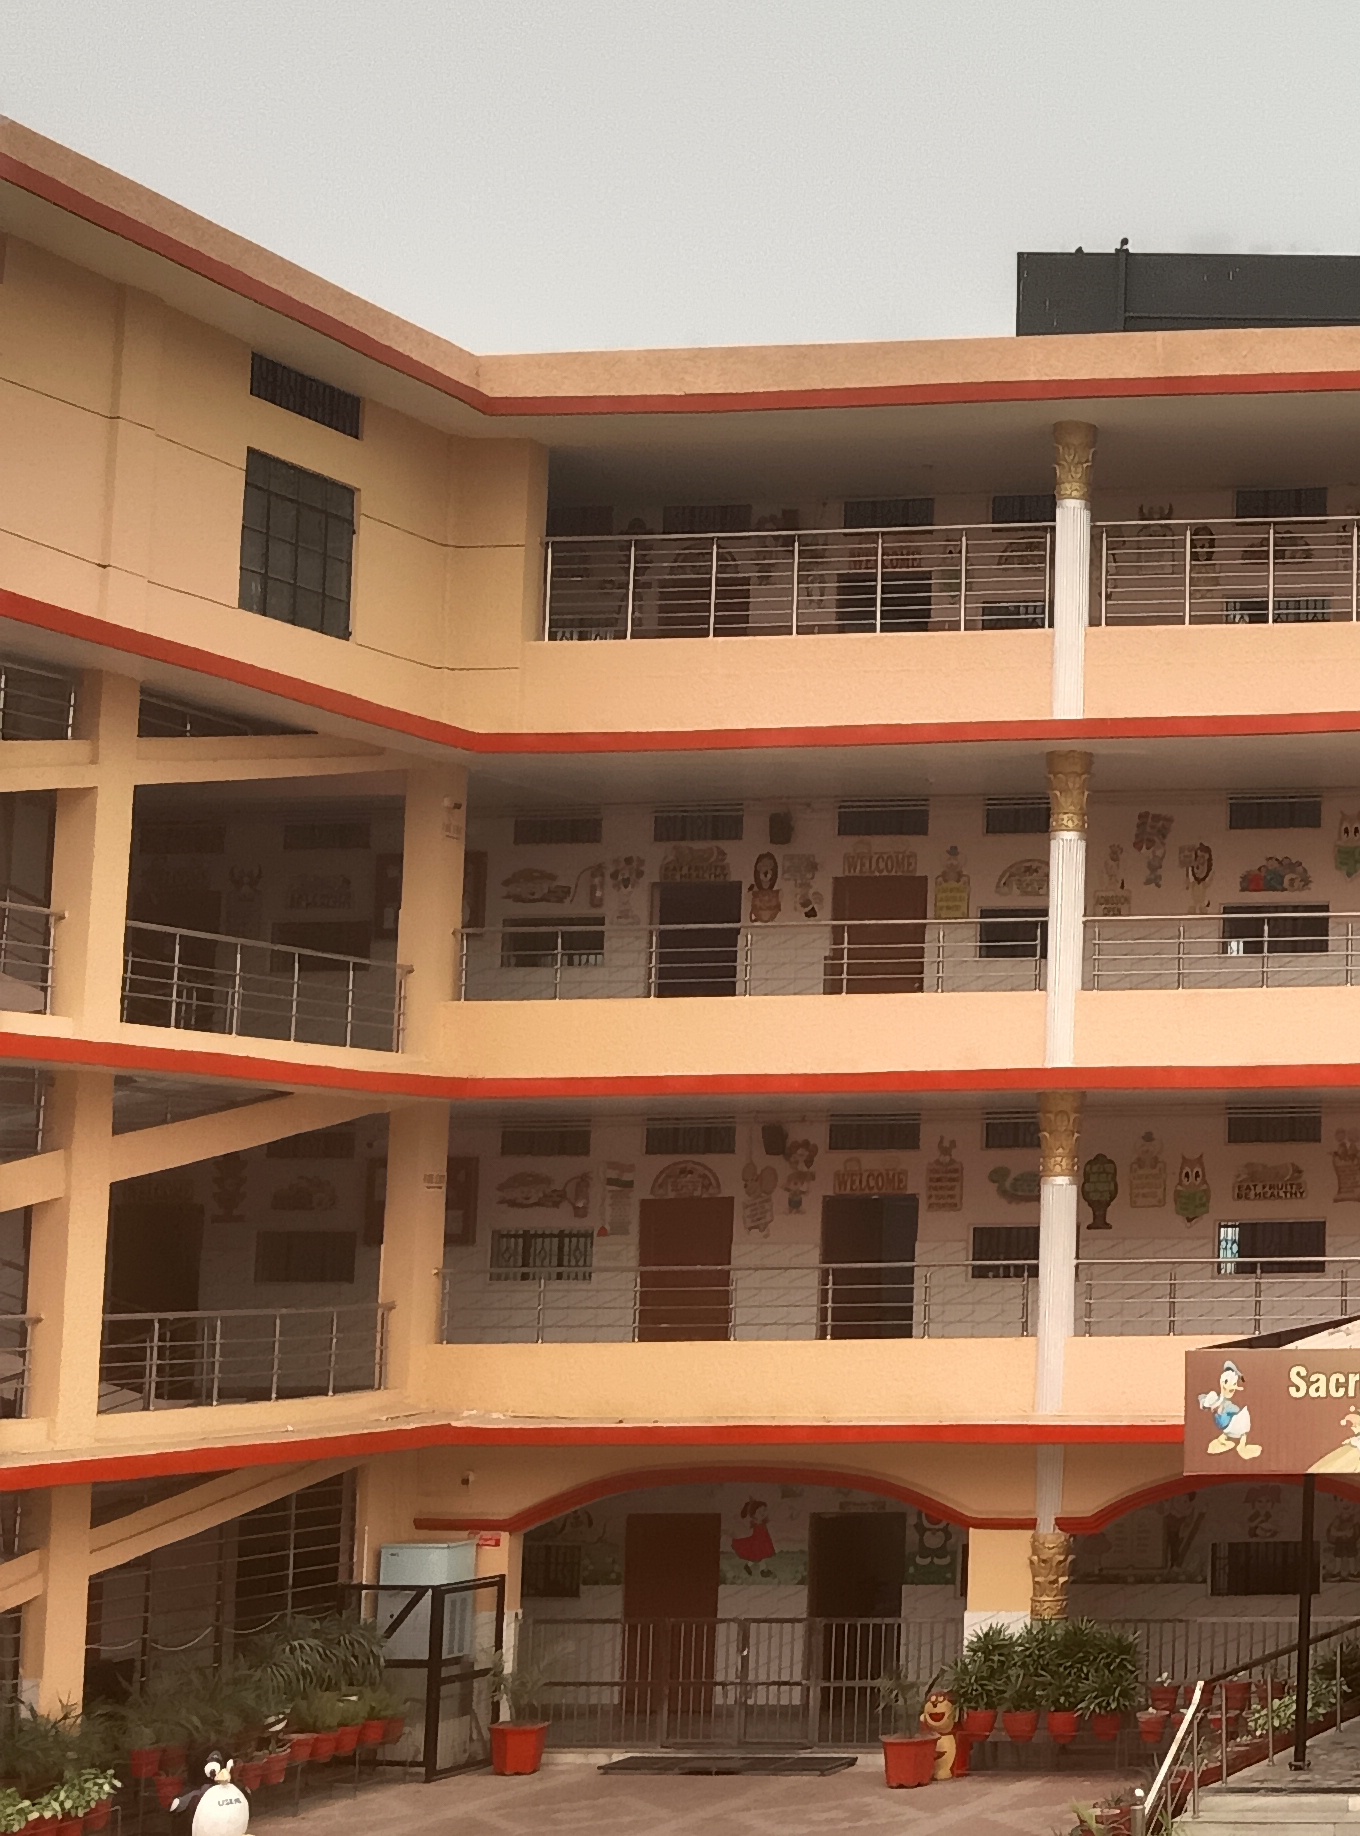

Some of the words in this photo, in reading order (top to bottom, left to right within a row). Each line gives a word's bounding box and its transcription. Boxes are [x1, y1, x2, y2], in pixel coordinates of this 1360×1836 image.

[846, 854, 914, 875] WELCOME
[836, 1172, 906, 1192] WELCOME
[1237, 1183, 1258, 1191] EAT
[1262, 1182, 1303, 1191] FRUITS
[1254, 1191, 1306, 1199] HEALTHY
